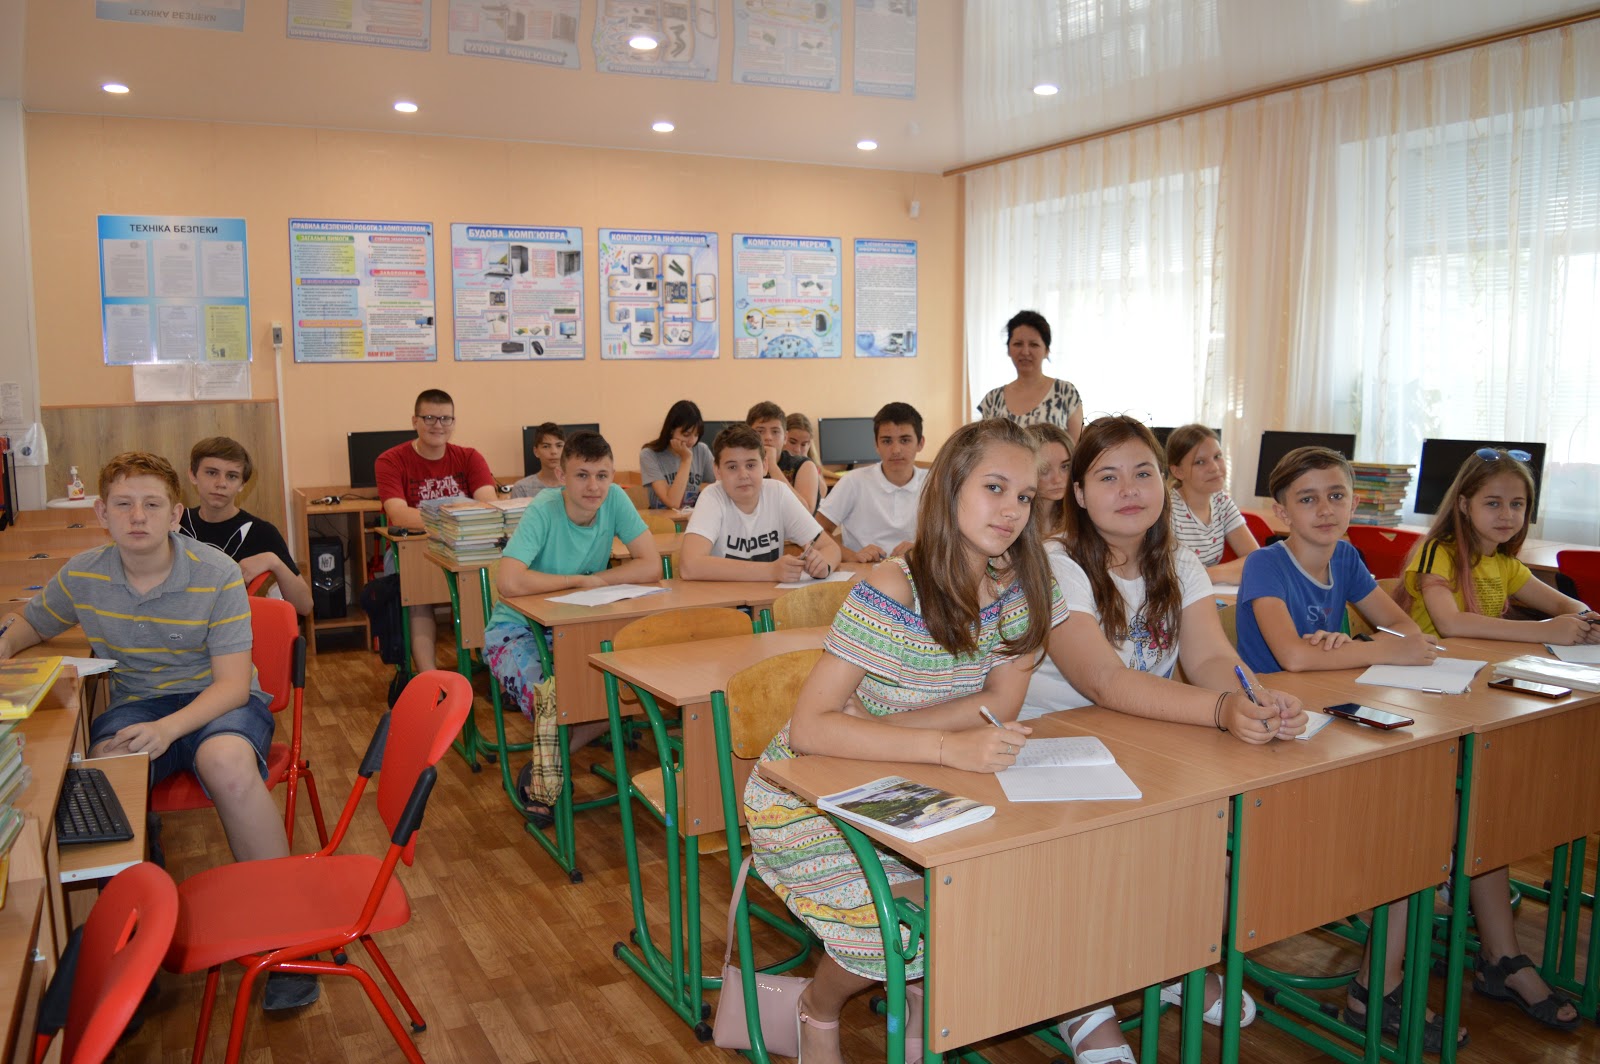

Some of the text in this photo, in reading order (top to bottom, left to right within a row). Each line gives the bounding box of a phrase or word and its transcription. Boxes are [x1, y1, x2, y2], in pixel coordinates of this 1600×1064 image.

[130, 224, 218, 234] ТЕХНІКА БЕЗПЕКИ
[468, 228, 566, 240] БУДОВА КОМП'ЮТЕРА
[611, 233, 652, 242] КОМП'ЮТЕР
[748, 239, 797, 247] КОМП'ЮТЕРНІ
[420, 486, 459, 500] WANT TO
[727, 530, 779, 552] UNDER
